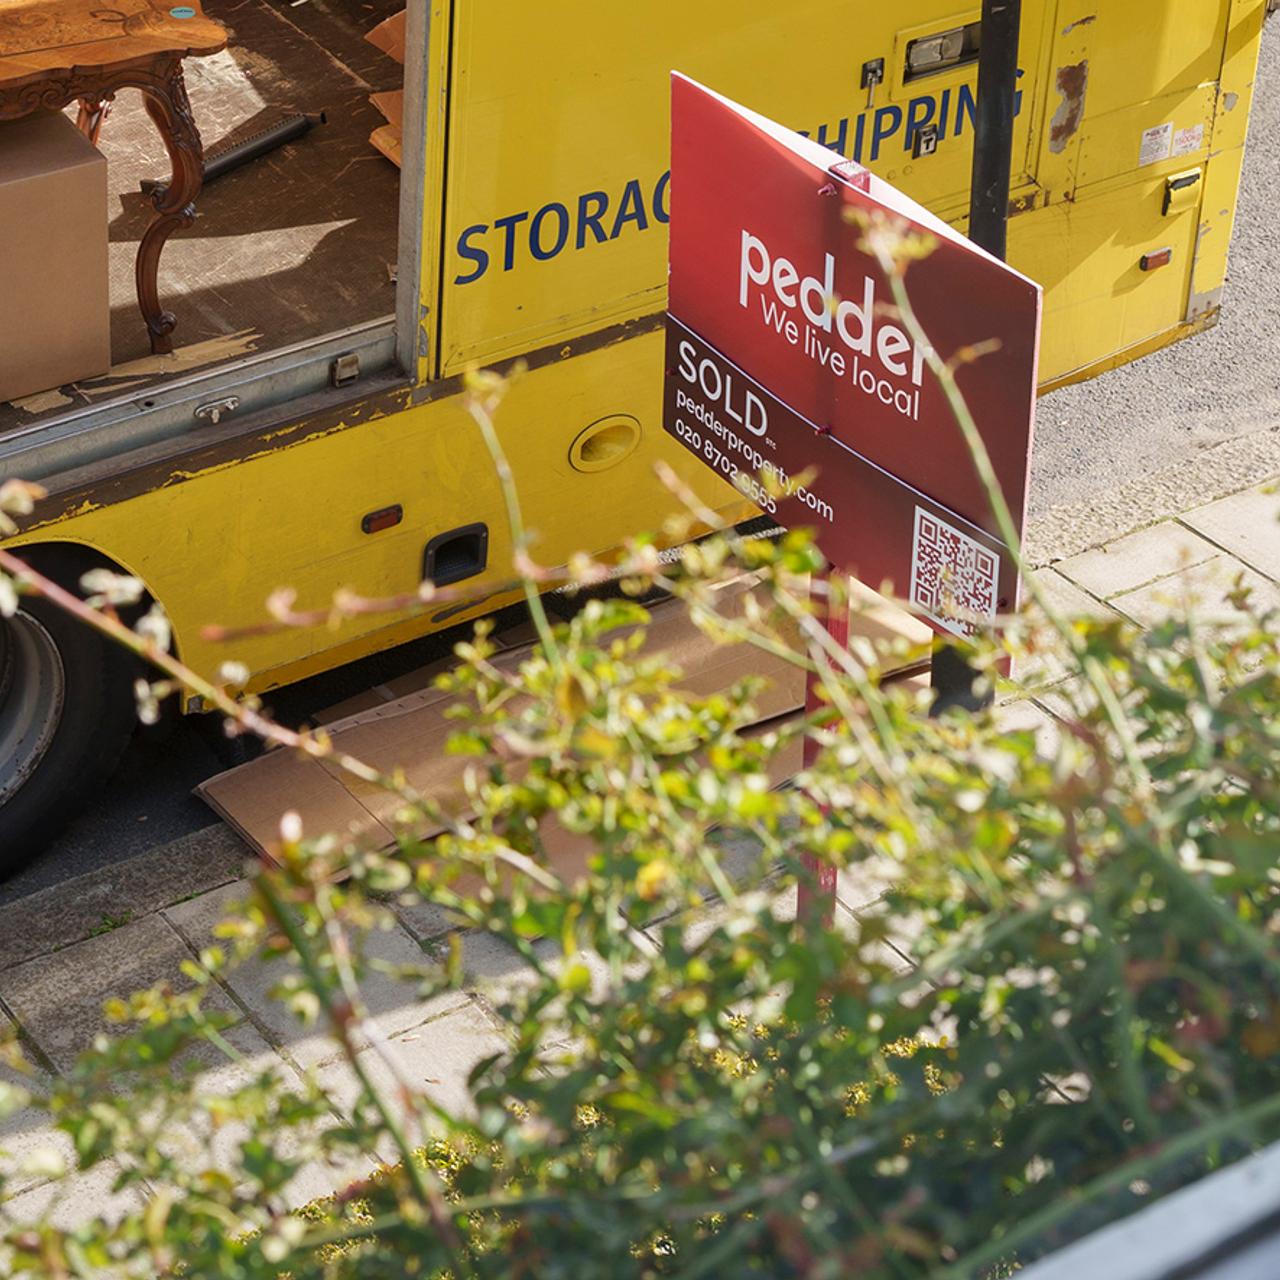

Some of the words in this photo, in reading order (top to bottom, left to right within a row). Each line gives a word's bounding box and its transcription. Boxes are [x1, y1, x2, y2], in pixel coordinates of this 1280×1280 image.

[796, 68, 1025, 163] HIPPIN
[678, 340, 768, 437] SOLD
[761, 293, 799, 345] We
[805, 325, 845, 377] live
[852, 355, 920, 421] local
[675, 419, 702, 450] 020
[703, 440, 739, 481] 8702
[676, 389, 834, 522] pedderproperty.com
